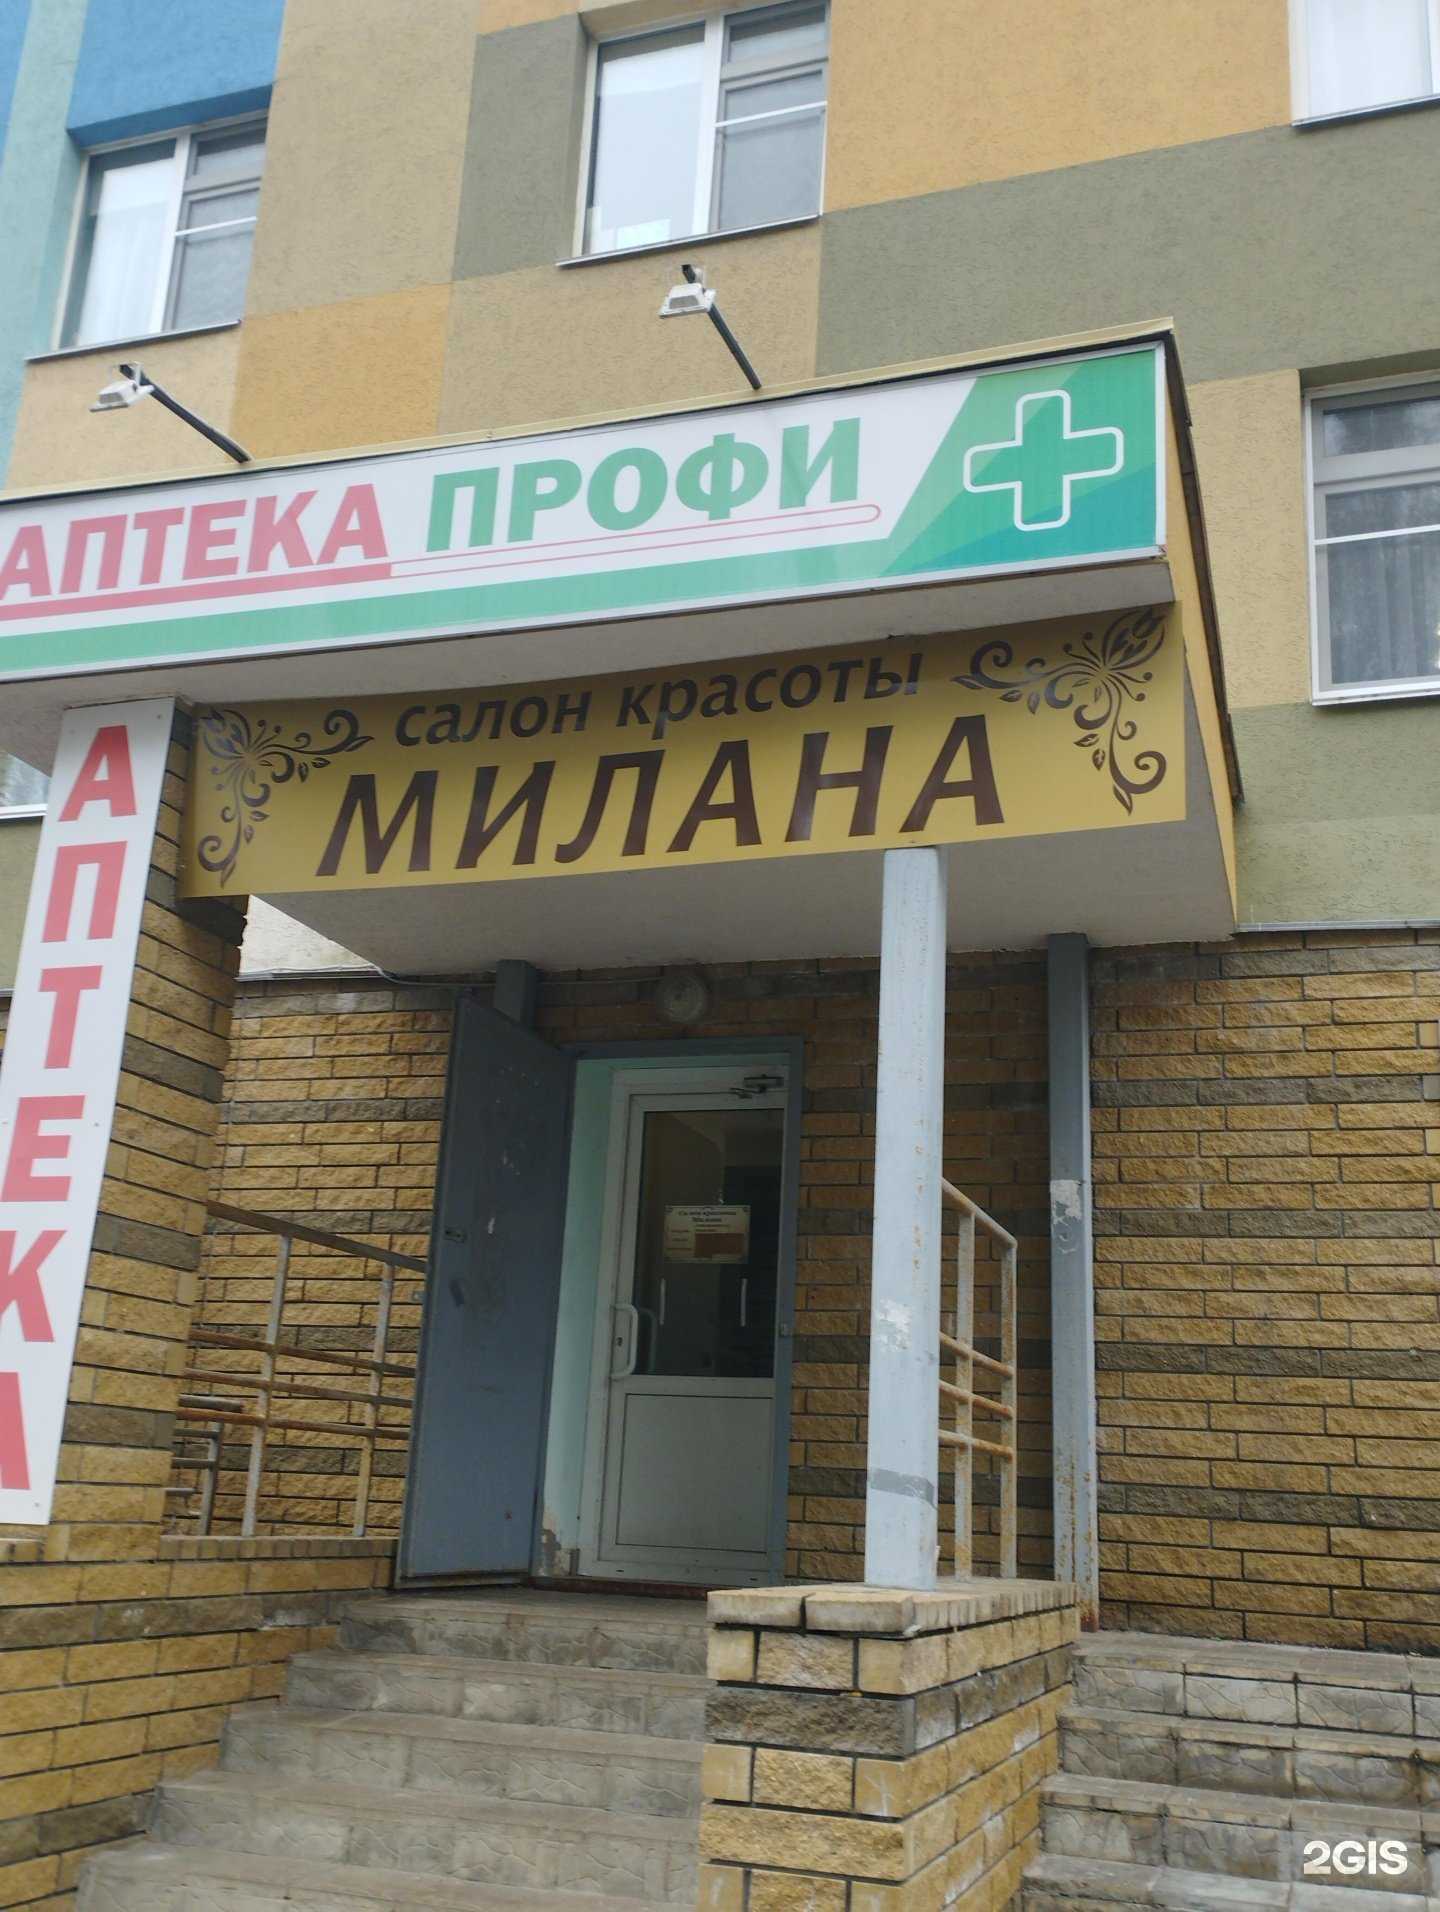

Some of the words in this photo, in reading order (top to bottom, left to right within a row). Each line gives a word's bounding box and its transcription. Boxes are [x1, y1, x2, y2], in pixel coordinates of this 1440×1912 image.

[0, 483, 389, 600] АПТЕКА
[426, 417, 860, 552] ПРОФИ
[395, 690, 593, 748] салон
[615, 652, 923, 740] красоты
[315, 713, 1005, 877] МИЛАНА
